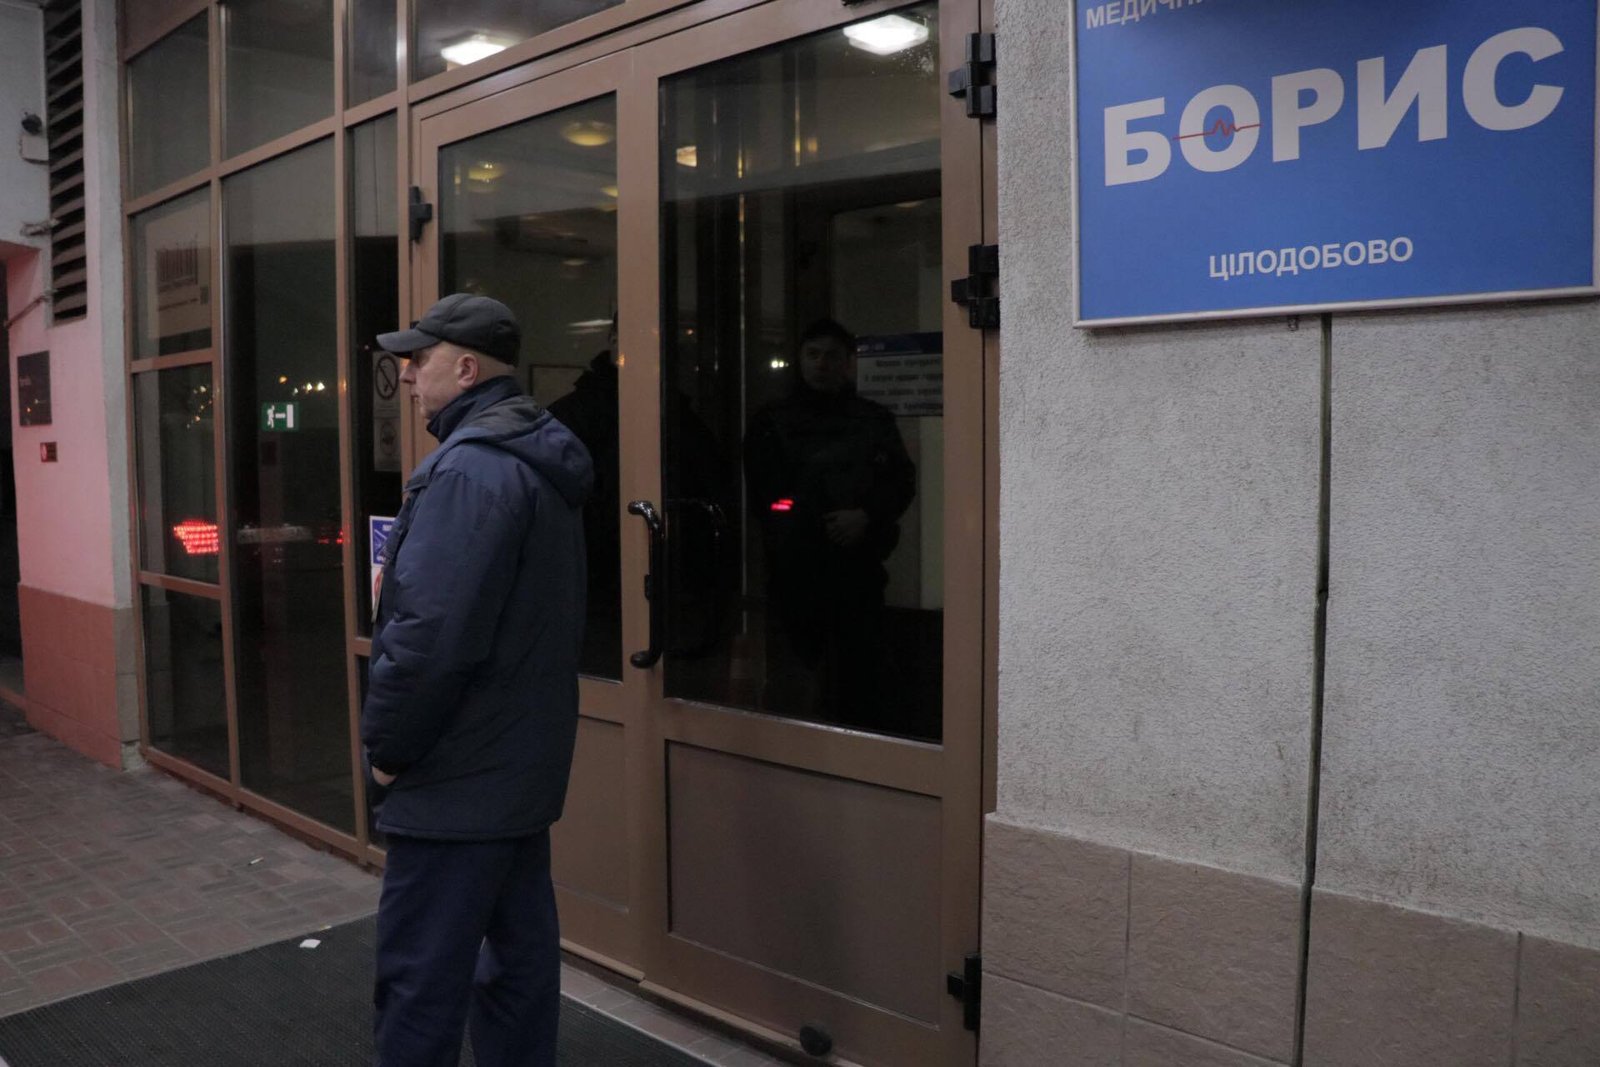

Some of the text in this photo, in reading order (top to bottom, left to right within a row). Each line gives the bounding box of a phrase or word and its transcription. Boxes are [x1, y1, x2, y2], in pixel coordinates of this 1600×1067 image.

[1086, 0, 1202, 29] МЕДИ
[1104, 26, 1564, 186] БОРИС
[1209, 236, 1413, 281] ЦІЛОДОБОВО
